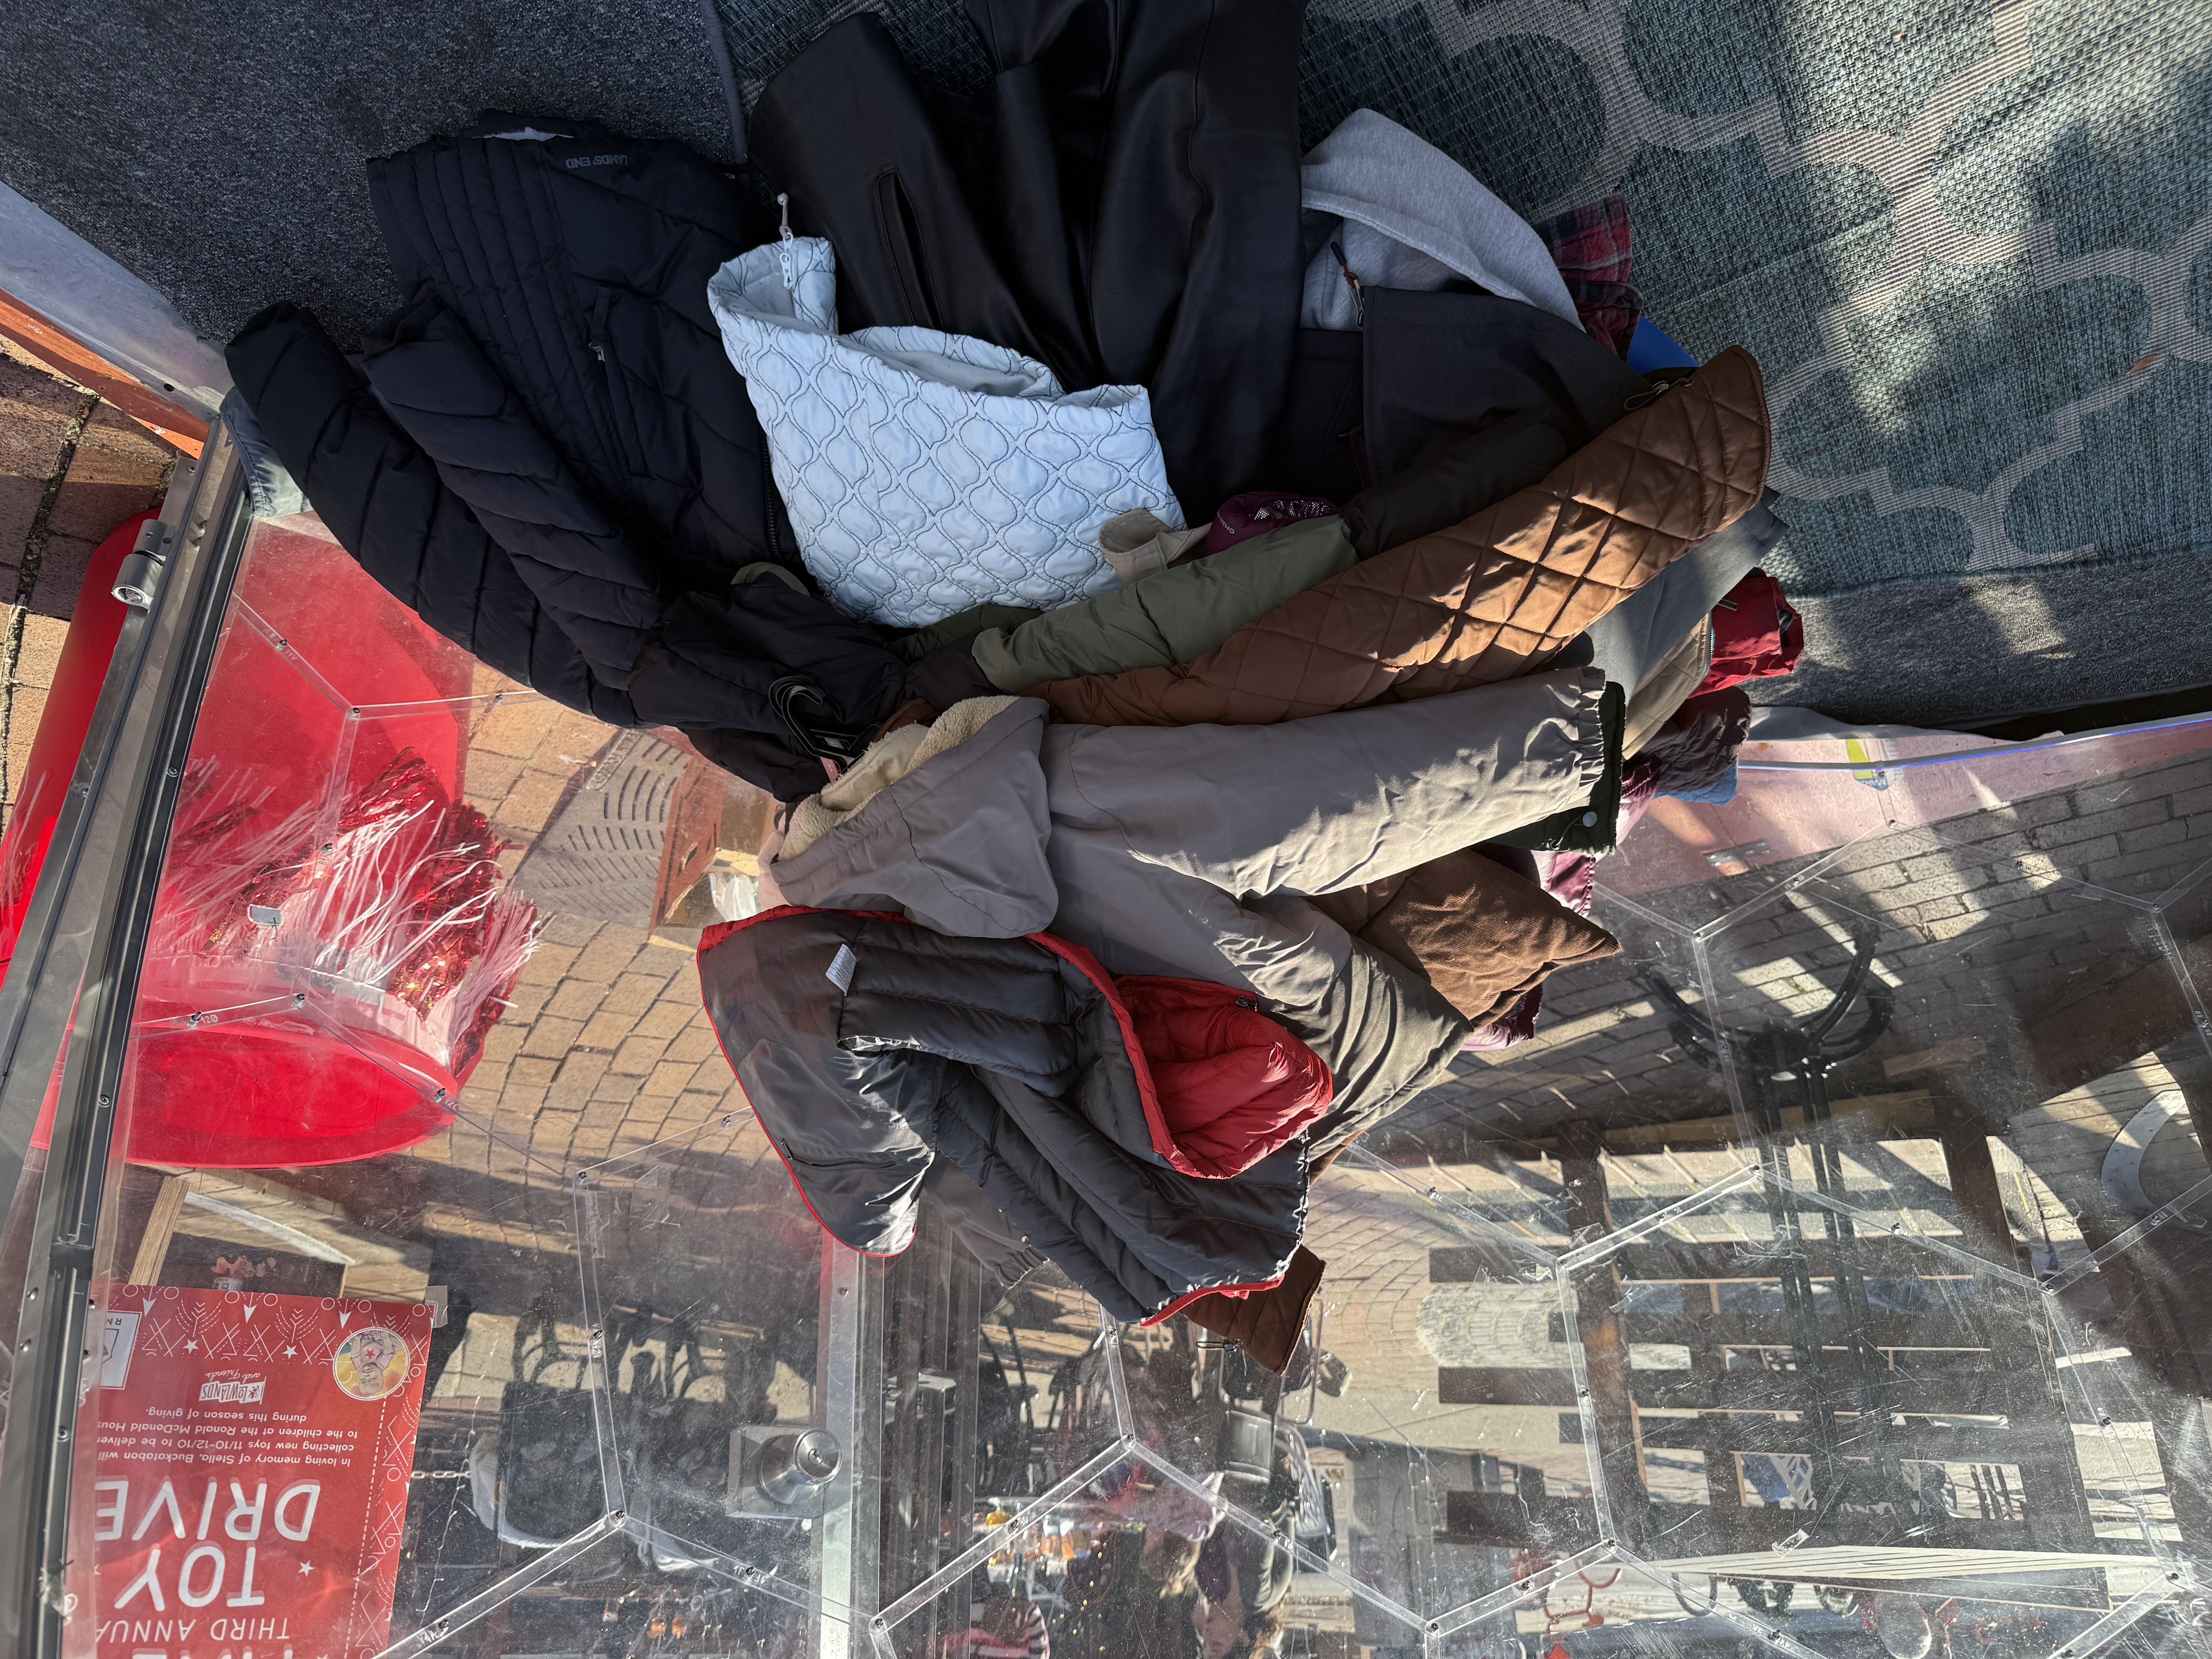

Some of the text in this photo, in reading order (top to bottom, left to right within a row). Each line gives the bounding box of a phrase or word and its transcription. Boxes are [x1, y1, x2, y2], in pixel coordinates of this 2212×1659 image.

[565, 155, 628, 169] LANDS' END
[205, 1369, 261, 1384] and Friends
[201, 1383, 248, 1401] LOWLANDS
[146, 1407, 183, 1418] giving.
[187, 1408, 199, 1419] of
[249, 1413, 267, 1422] this
[272, 1412, 307, 1424] during
[130, 1423, 190, 1434] McDonald
[195, 1425, 235, 1435] Ronald
[241, 1427, 258, 1436] the
[279, 1429, 322, 1438] children
[326, 1430, 343, 1438] the
[348, 1431, 357, 1439] to
[141, 1437, 156, 1447] be
[161, 1439, 172, 1447] to
[177, 1439, 242, 1450] 11/10-12/10
[248, 1439, 270, 1450] toys
[303, 1441, 354, 1453] collecting
[98, 1451, 350, 1467] In loving memory of Stella, Buckatabon will
[94, 1479, 321, 1541] DRIVE
[114, 1544, 264, 1611] TOY
[210, 1618, 290, 1640] THIRD
